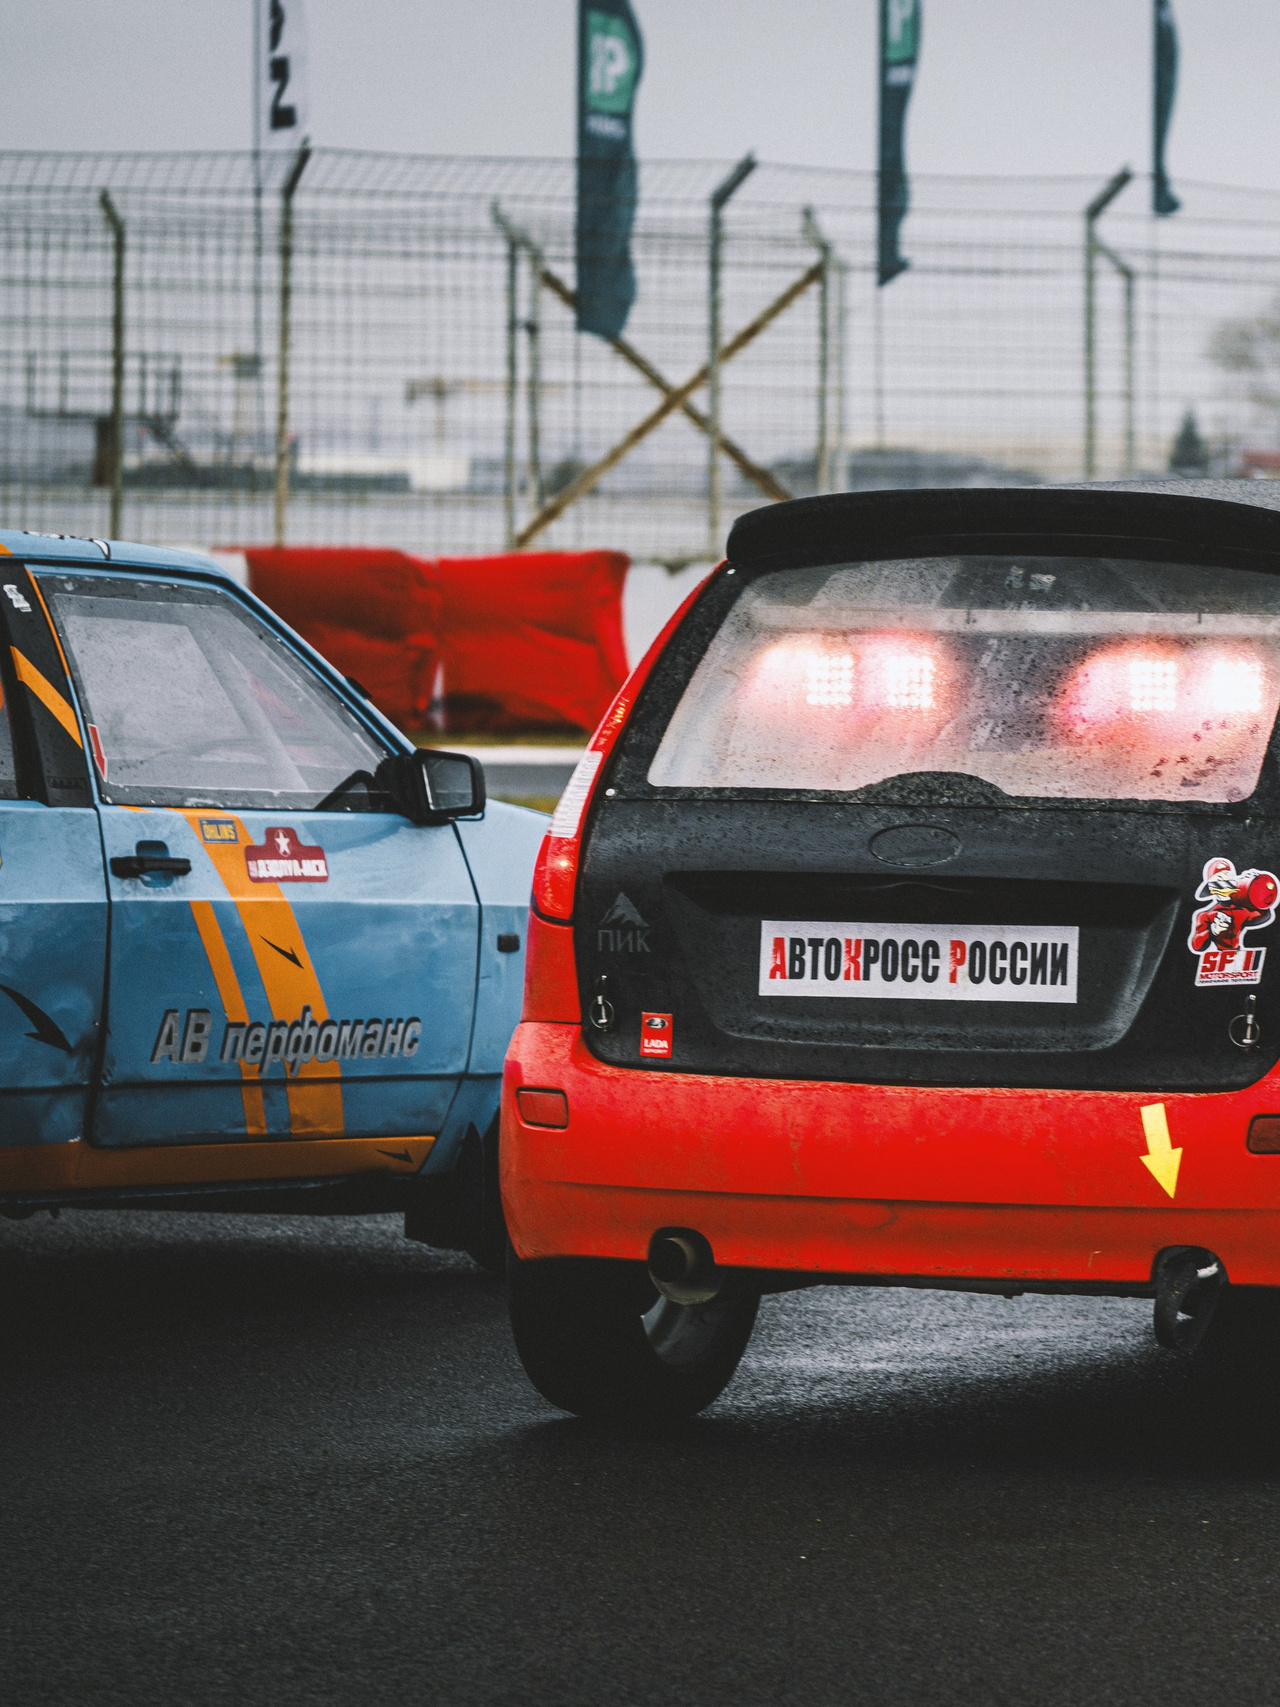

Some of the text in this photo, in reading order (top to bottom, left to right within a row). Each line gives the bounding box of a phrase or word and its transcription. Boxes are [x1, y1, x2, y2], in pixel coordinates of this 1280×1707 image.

[597, 929, 651, 952] ПИК
[768, 936, 1069, 986] АВТОКРОСС РОССИИ
[1200, 950, 1238, 973] SF
[1199, 970, 1260, 980] MOTORSPORT
[150, 1004, 423, 1078] АВ перфоманс
[643, 1038, 669, 1048] LADA
